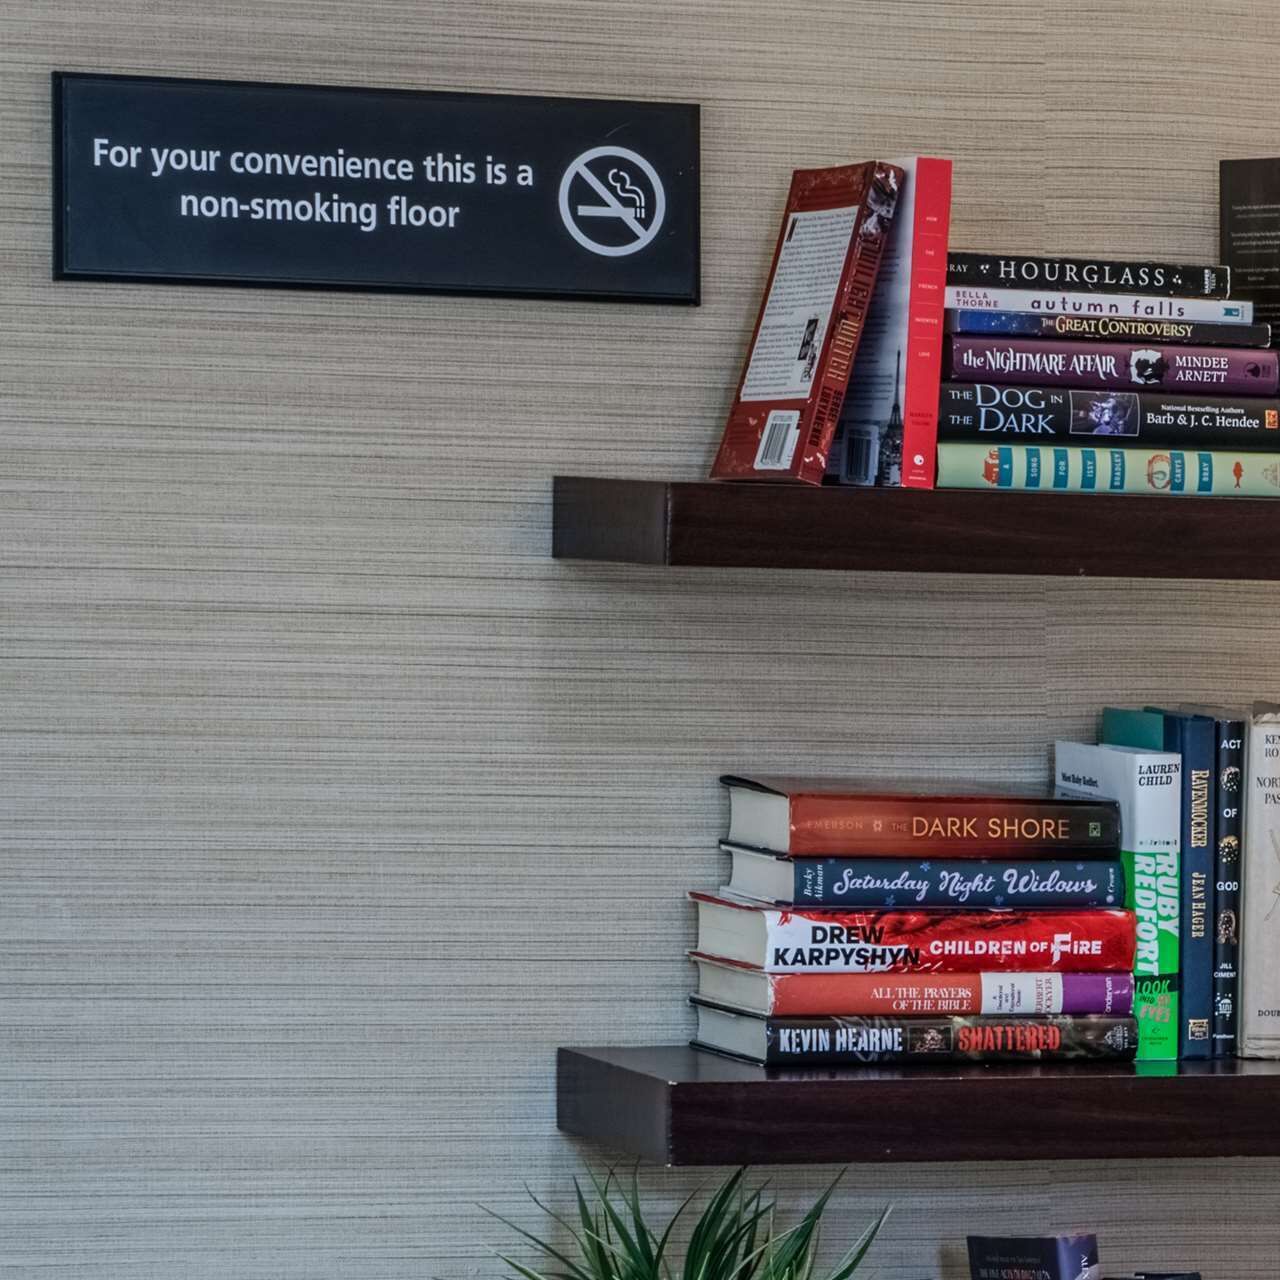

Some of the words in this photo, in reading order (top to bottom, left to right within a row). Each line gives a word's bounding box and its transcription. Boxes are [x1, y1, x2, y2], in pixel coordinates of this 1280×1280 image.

[93, 138, 141, 168] For
[151, 148, 221, 177] your
[230, 150, 413, 180] convenience
[424, 154, 475, 183] this
[486, 156, 507, 185] is
[517, 163, 534, 186] a
[180, 193, 377, 232] non-smoking
[386, 196, 460, 228] floor
[847, 238, 881, 320] TWILIGHT
[999, 260, 1165, 287] HOURGLASS
[955, 291, 989, 299] BELLA
[956, 299, 998, 308] THORNE
[1031, 297, 1119, 313] autumn
[1133, 300, 1184, 317] falls
[1055, 316, 1097, 333] GREAT
[1099, 318, 1193, 337] CONTROVERSY
[827, 319, 860, 382] WATCH
[963, 349, 985, 367] the
[985, 347, 1066, 375] NIGHTMARE
[1069, 352, 1118, 380] AFFAIR
[1176, 356, 1228, 368] MINDEE
[1176, 370, 1228, 383] ARNETT
[949, 390, 973, 400] THE
[975, 384, 1045, 408] DOG
[1050, 395, 1063, 404] IN
[949, 415, 973, 425] THE
[978, 407, 1056, 434] DARK
[1147, 413, 1174, 424] Barb
[1177, 414, 1188, 425] &
[1190, 415, 1198, 427] J.
[1201, 415, 1213, 426] C.
[1216, 416, 1260, 428] Hendee
[1031, 456, 1039, 477] SONG
[1086, 460, 1094, 477] ISSY
[1220, 739, 1242, 750] ACT
[1138, 763, 1180, 776] LAUREN
[1138, 775, 1173, 787] CHILD
[1191, 769, 1209, 848] RAVENMOCKER
[1223, 807, 1238, 818] OF
[808, 820, 863, 831] EMERSON
[891, 822, 908, 832] THE
[912, 816, 979, 838] DARK
[988, 818, 1071, 839] SHORE
[803, 867, 815, 896] Becky
[814, 864, 823, 901] Aikman
[833, 868, 929, 901] Saturday
[938, 869, 996, 902] Night
[1002, 868, 1097, 894] Widows
[1192, 871, 1206, 900] JEAN
[1216, 881, 1239, 892] GOD
[1156, 850, 1180, 938] RUBY
[1134, 853, 1159, 976] REDFORT
[1191, 902, 1206, 938] HAGER
[811, 926, 885, 945] DREW
[774, 946, 920, 967] KARPYSHYN
[930, 940, 1027, 955] CHILDREN
[1029, 942, 1048, 952] OF
[1213, 970, 1236, 978] CIMENT
[1219, 962, 1232, 970] JILL
[870, 988, 895, 999] ALL
[896, 988, 920, 999] THE
[924, 988, 972, 999] PRAYERS
[1137, 980, 1171, 994] LOOK
[892, 1000, 909, 1010] OF
[911, 1000, 935, 1010] THE
[937, 1000, 971, 1011] BIBLE
[779, 1028, 830, 1053] KEVIN
[835, 1027, 903, 1052] HEARNE
[958, 1025, 1062, 1051] SHATTERED
